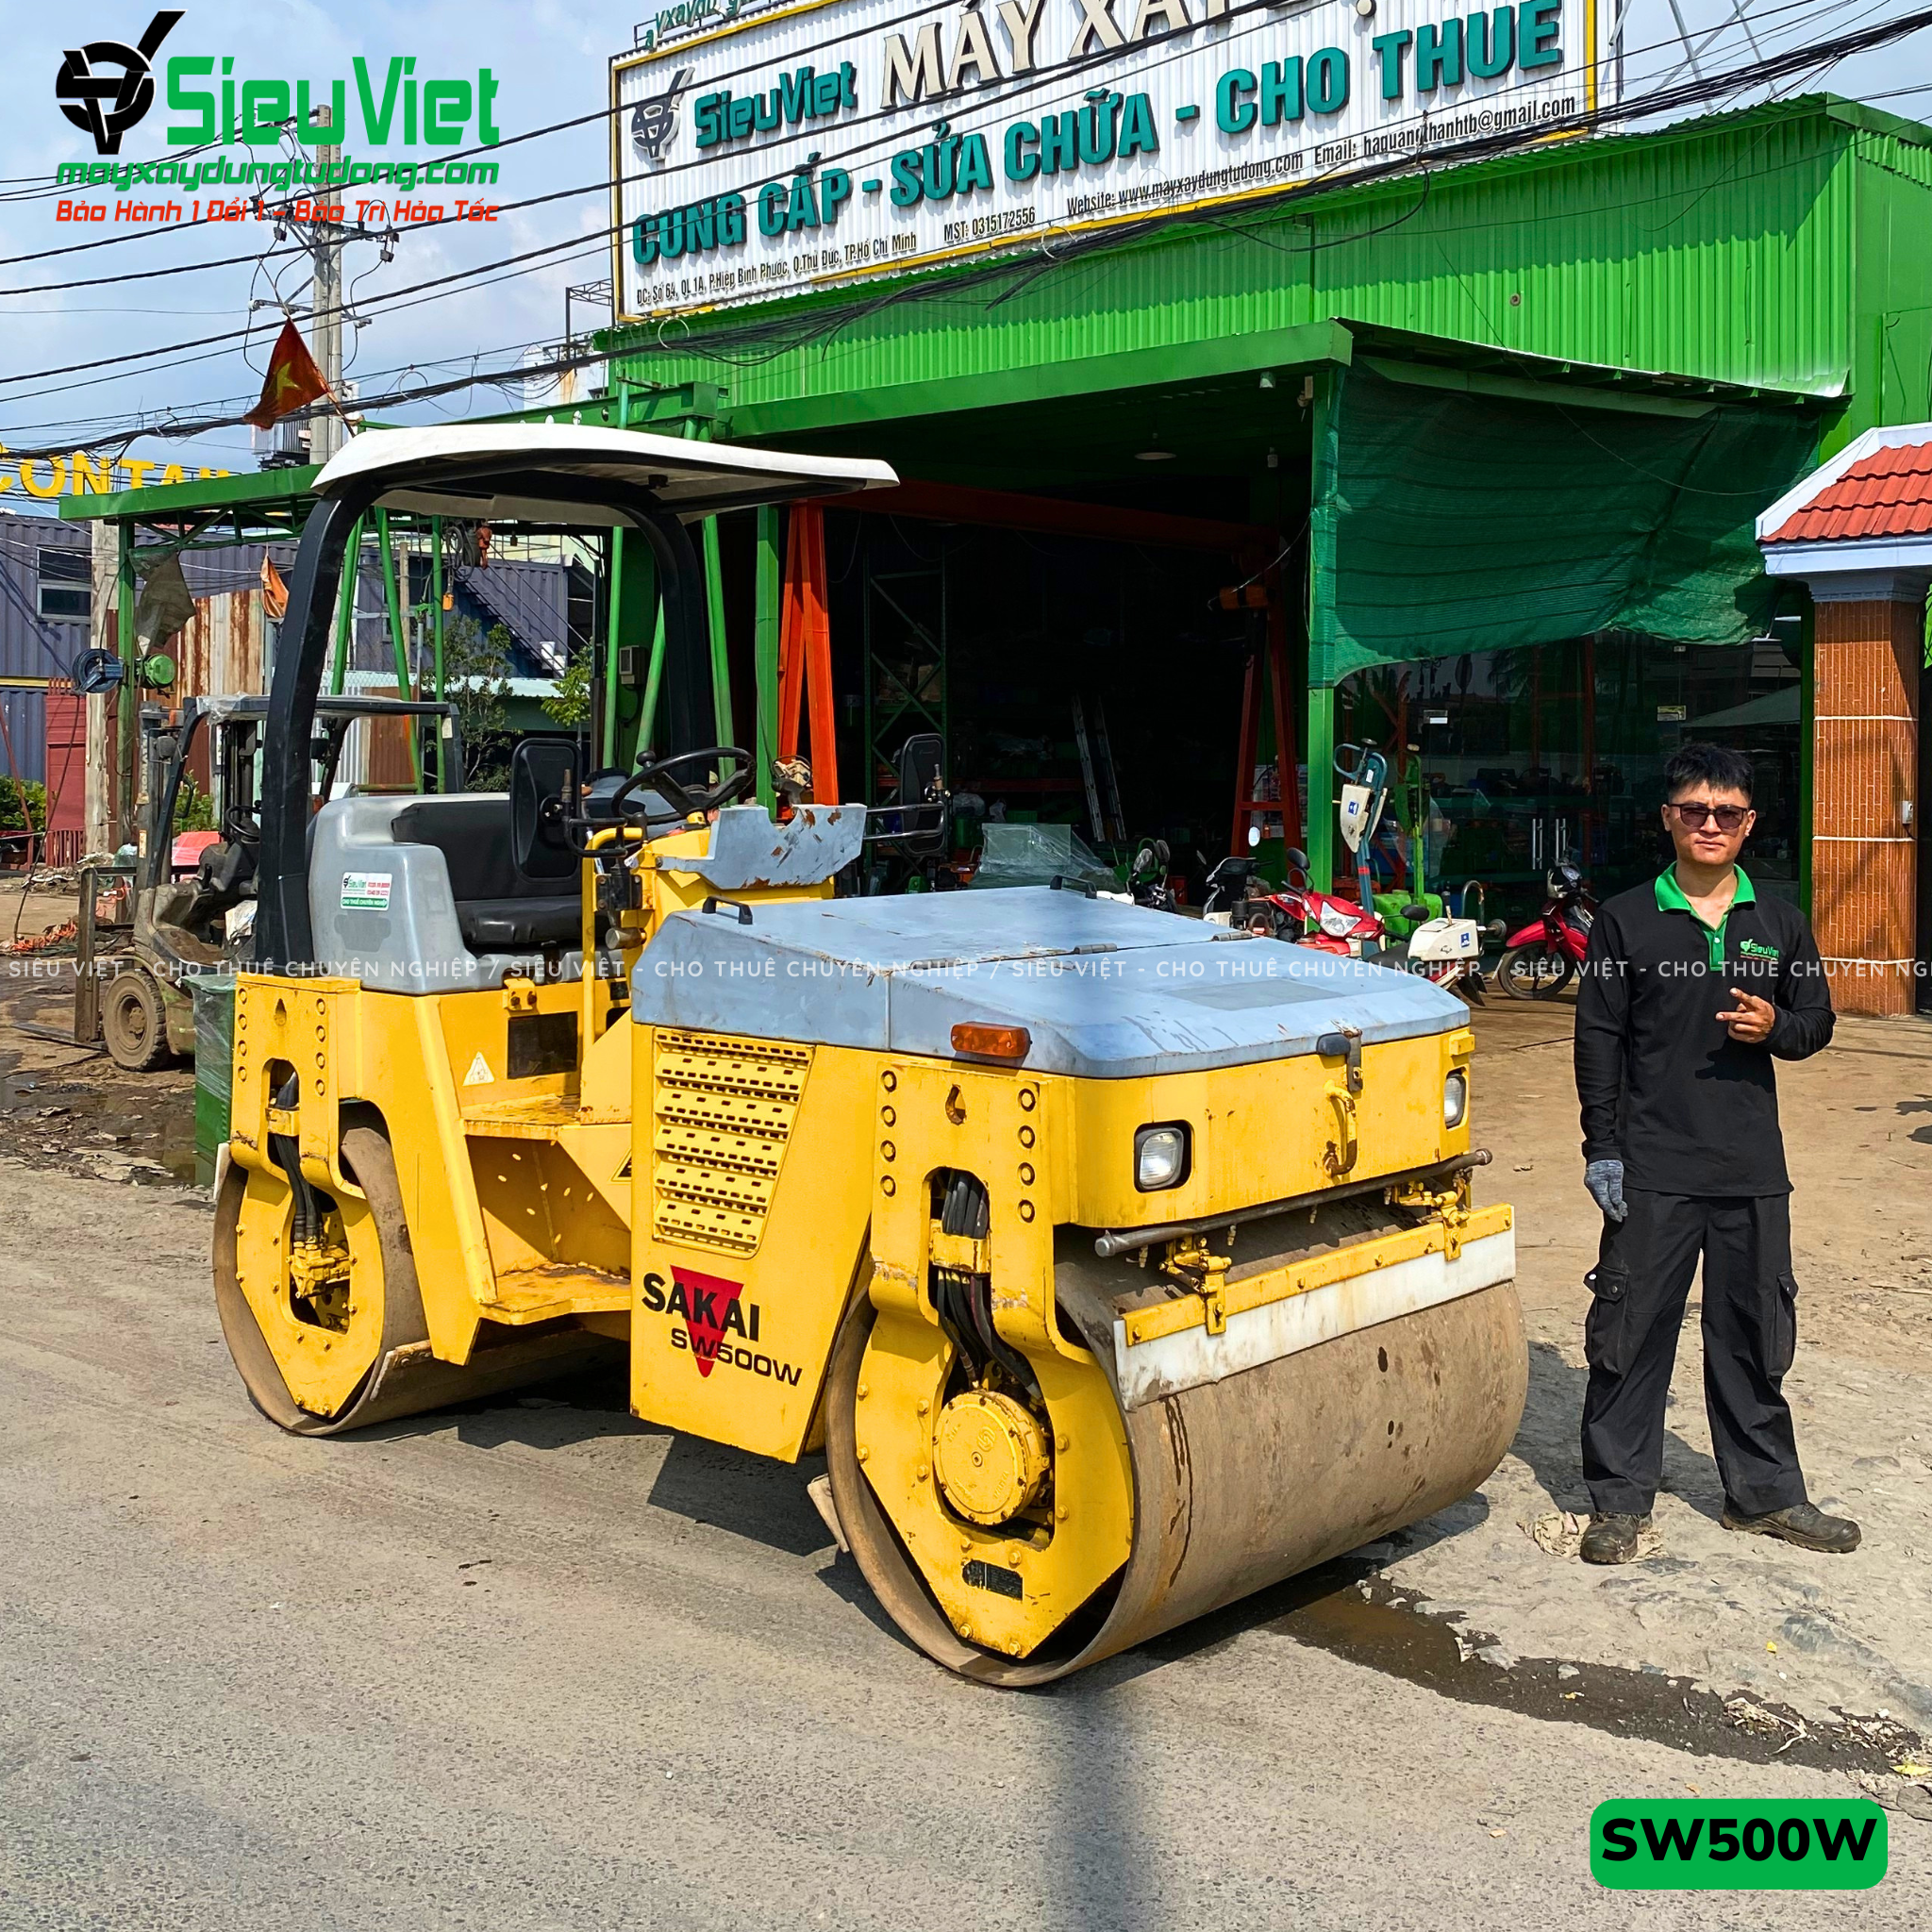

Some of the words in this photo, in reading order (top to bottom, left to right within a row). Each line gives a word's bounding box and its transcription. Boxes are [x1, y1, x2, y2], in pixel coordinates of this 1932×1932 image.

[694, 61, 858, 148] SieuViet
[631, 192, 747, 264] CUNG
[758, 152, 853, 237] CẤP
[890, 123, 994, 207] SỬA
[1005, 88, 1159, 181] CHỮA
[1216, 46, 1350, 134] CHO
[1067, 190, 1116, 216] Website:
[1314, 142, 1357, 165] Email:
[944, 221, 969, 242] MST:
[973, 206, 1036, 236] 0315172556
[681, 278, 691, 295] QL
[873, 235, 889, 256] Chí
[891, 231, 917, 252] Minh
[641, 1273, 760, 1342] SAKAI
[671, 1327, 803, 1387] SW500W
